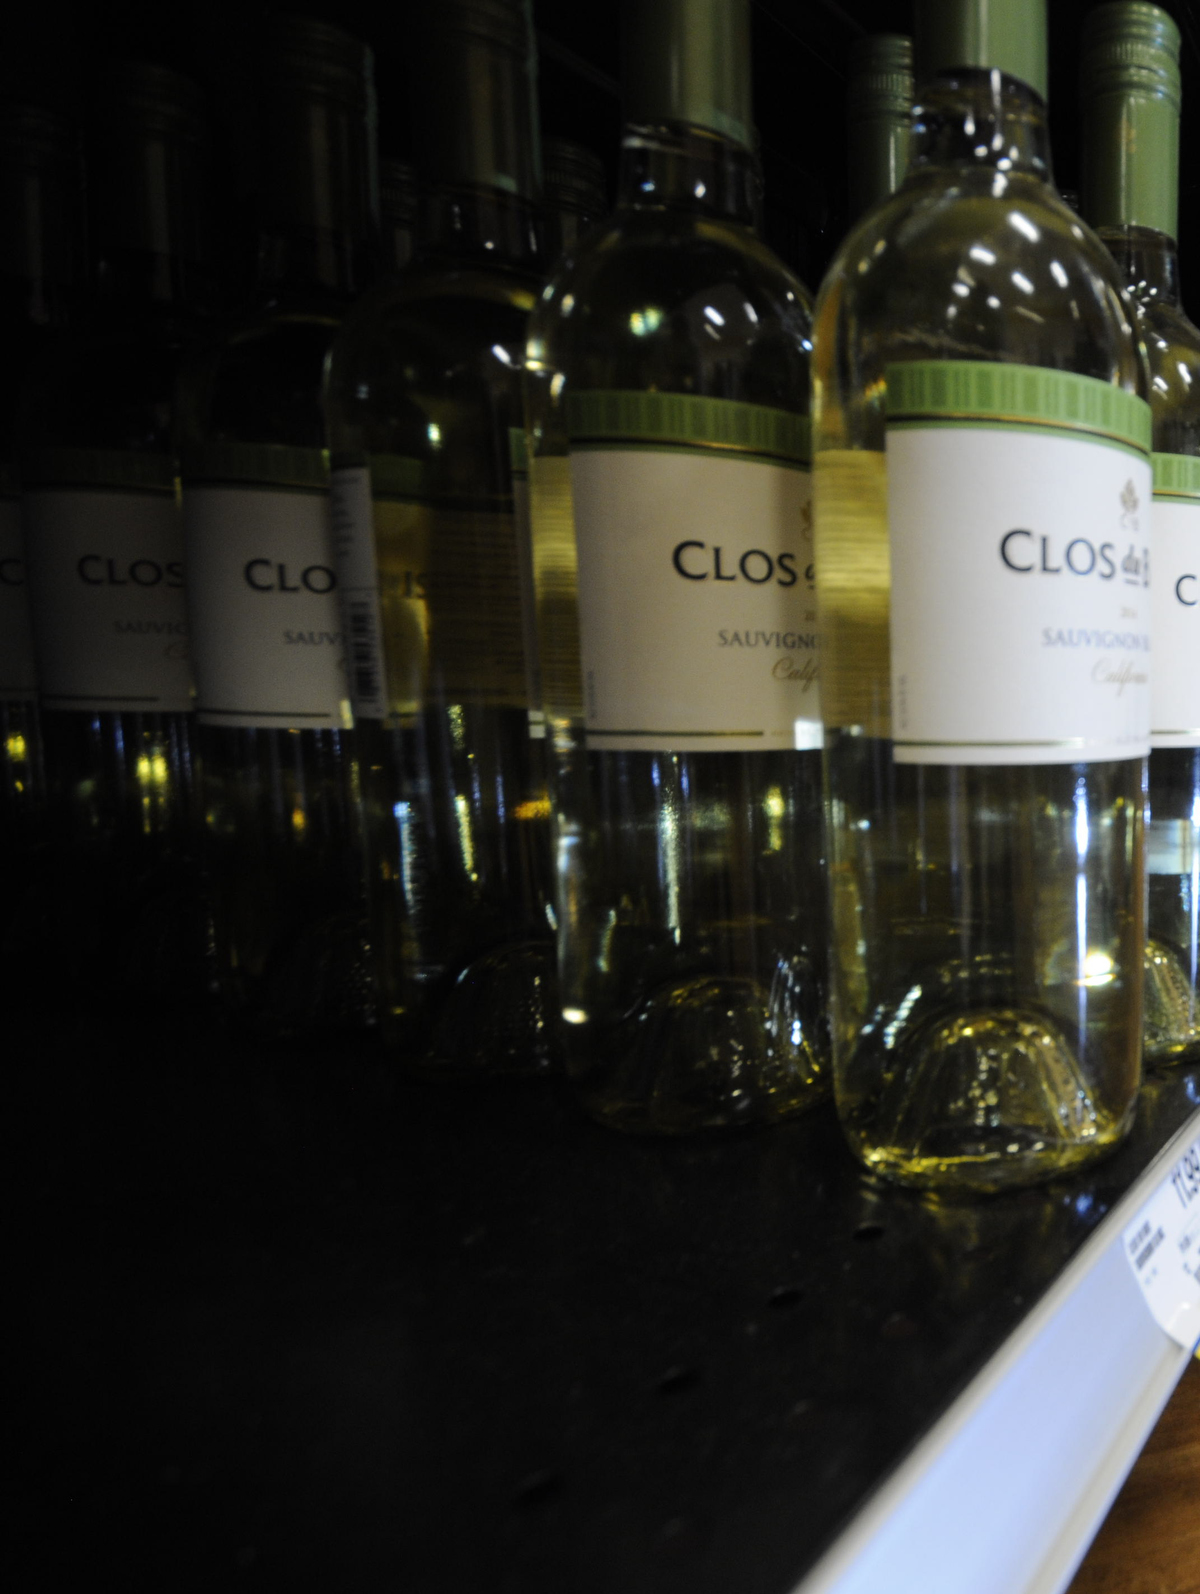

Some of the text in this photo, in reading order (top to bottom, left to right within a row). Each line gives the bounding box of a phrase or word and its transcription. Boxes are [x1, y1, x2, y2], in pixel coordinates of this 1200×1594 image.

[77, 554, 185, 588] CLOS
[673, 540, 798, 587] CLOS
[1000, 529, 1116, 580] CLOS
